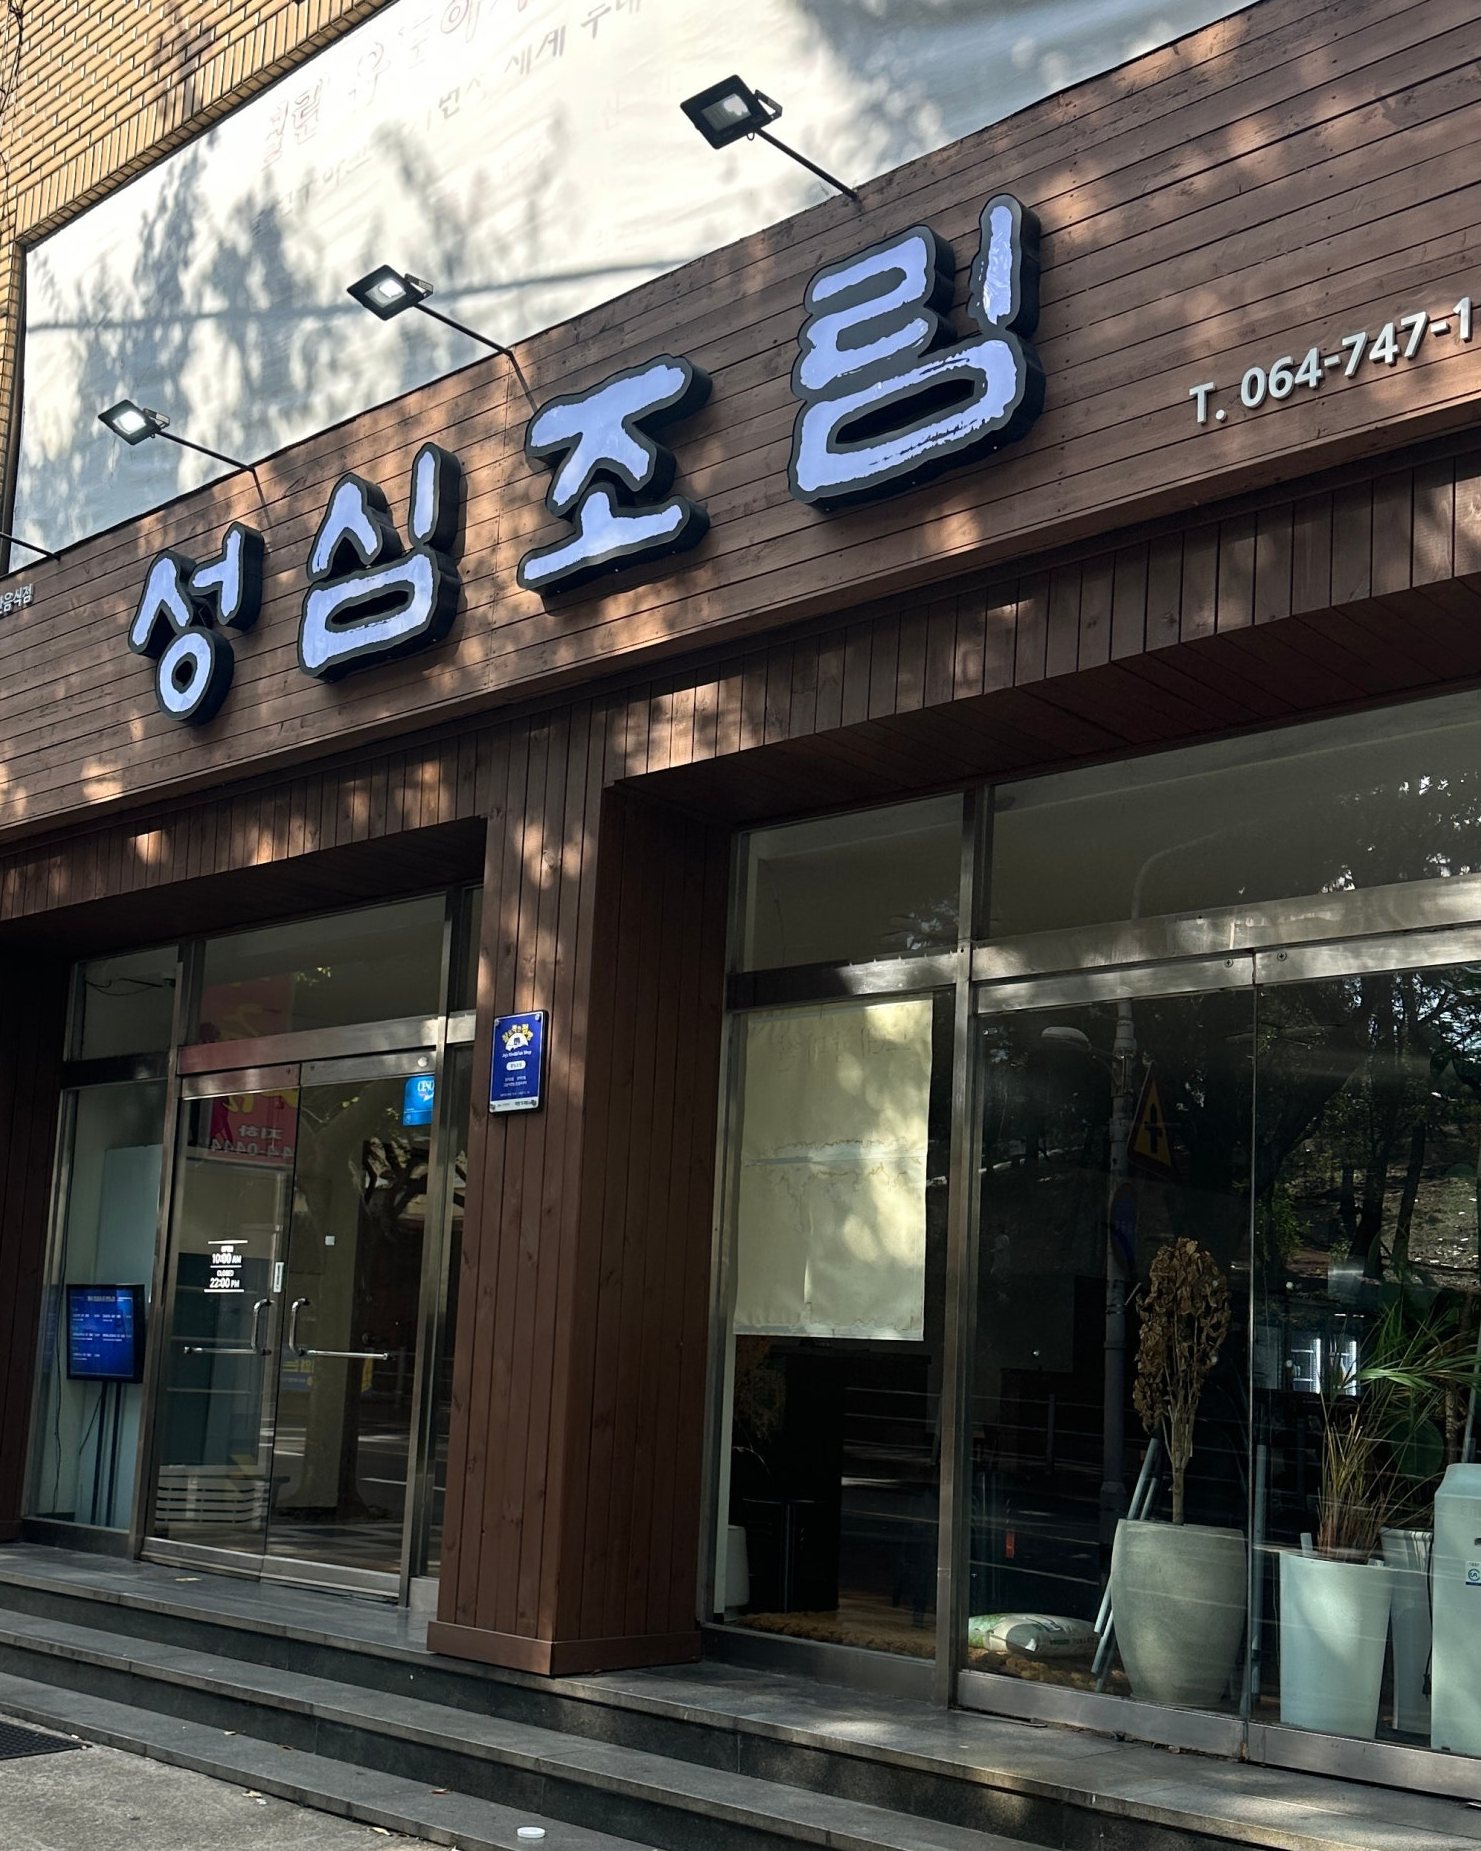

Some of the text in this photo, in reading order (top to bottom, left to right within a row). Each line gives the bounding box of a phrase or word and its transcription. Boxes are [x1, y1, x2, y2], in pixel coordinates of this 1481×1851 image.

[1189, 297, 1473, 424] T. 064-747-1
[130, 196, 1030, 716] 성심조림
[209, 1277, 240, 1288] 22:00 PM
[212, 1253, 242, 1264] 10:00 AM
